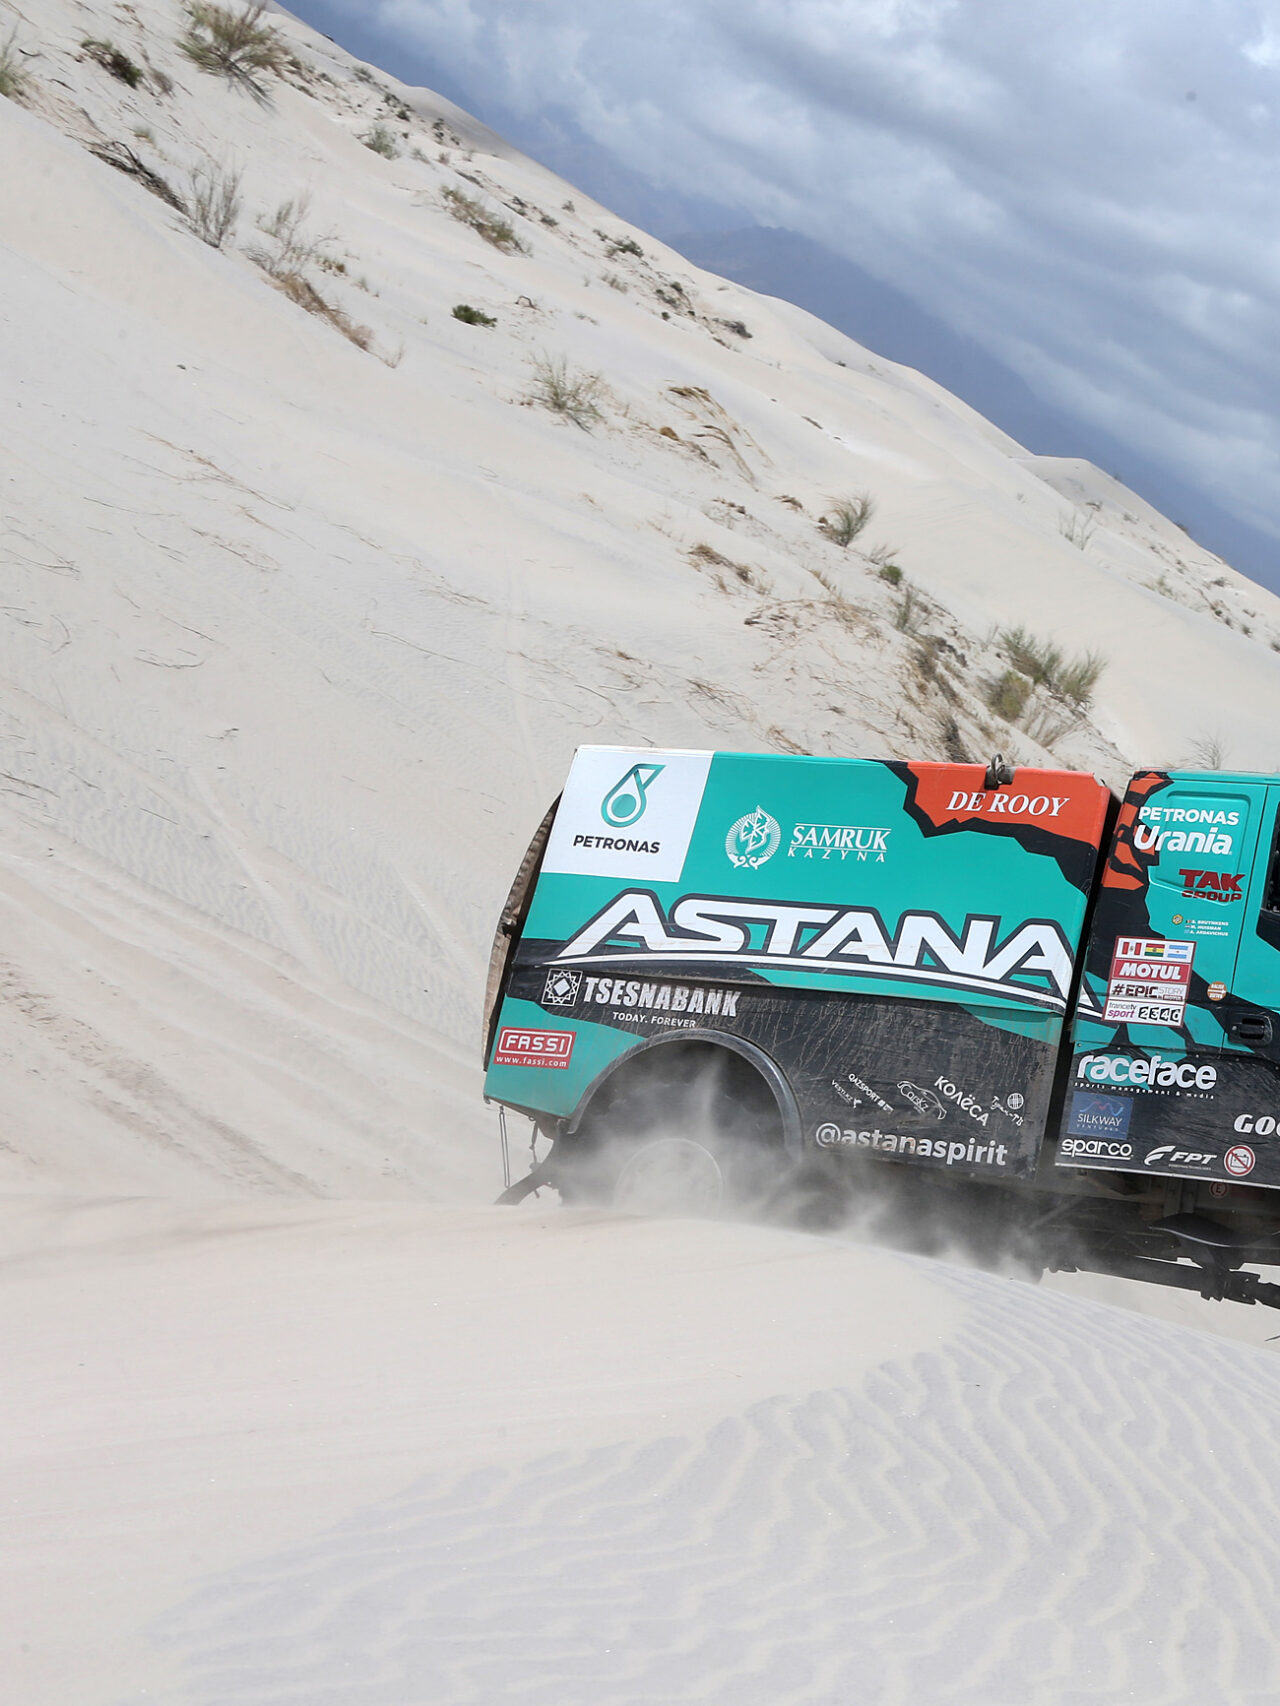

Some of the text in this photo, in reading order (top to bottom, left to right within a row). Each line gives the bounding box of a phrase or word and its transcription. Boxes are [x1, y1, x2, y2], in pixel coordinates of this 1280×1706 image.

[946, 791, 1070, 817] DE ROOY
[1138, 806, 1240, 826] PETRONAS
[573, 834, 661, 854] PETRONAS
[790, 824, 890, 851] SAMRUK
[1133, 825, 1233, 855] Urania
[788, 847, 886, 863] KAZYNA
[1179, 868, 1246, 892] TAK
[1181, 889, 1243, 903] GROUP
[557, 893, 1094, 1007] ASTANA
[1120, 962, 1182, 980] MOTUL
[583, 976, 742, 1018] TSESNABANK
[612, 1011, 696, 1029] TODAY. FOREVER
[1107, 1009, 1135, 1019] sport
[505, 1034, 566, 1052] FASSI
[495, 1055, 568, 1068] www.fassi.com
[1077, 1054, 1218, 1091] raceface
[849, 1073, 881, 1103] QAZSPORT
[1074, 1082, 1106, 1090] sports
[1111, 1085, 1171, 1096] management
[1186, 1092, 1215, 1101] media
[1077, 1113, 1123, 1127] SILKWAY
[815, 1122, 1008, 1166] @astanaspirit
[1060, 1138, 1133, 1158] sparco
[1169, 1151, 1218, 1165] FPT
